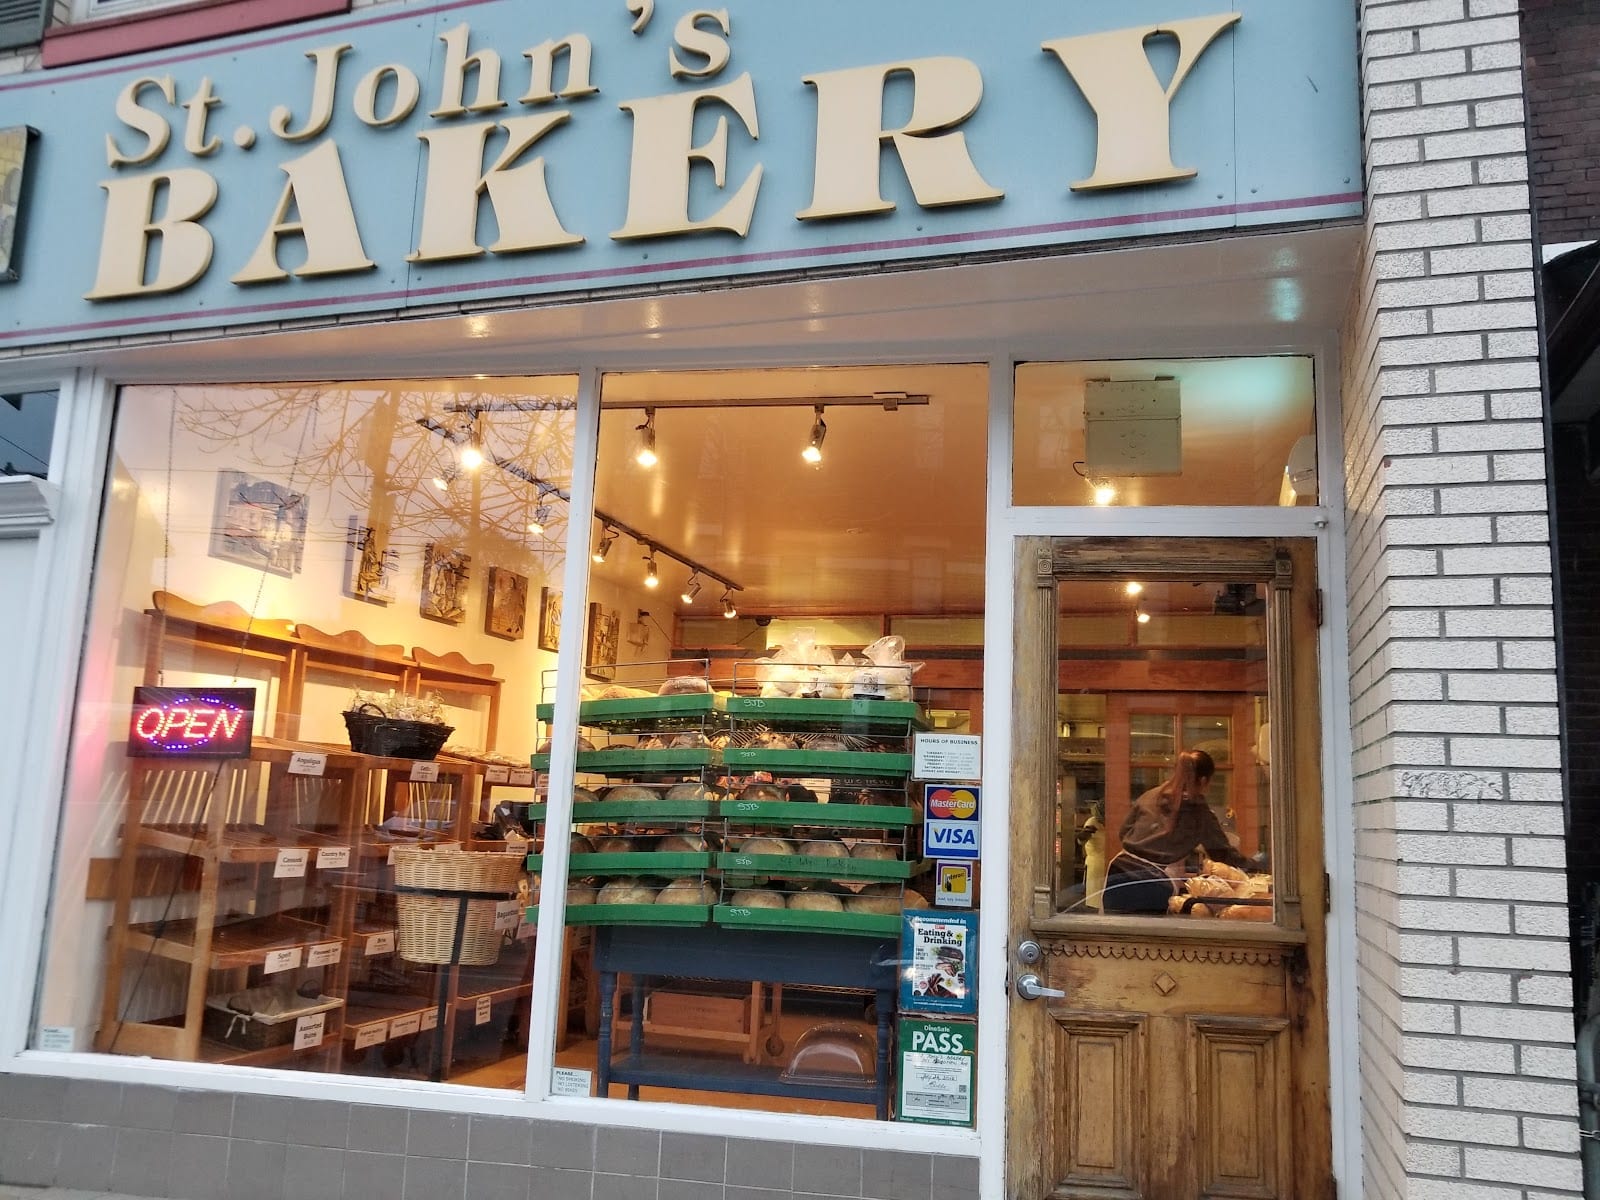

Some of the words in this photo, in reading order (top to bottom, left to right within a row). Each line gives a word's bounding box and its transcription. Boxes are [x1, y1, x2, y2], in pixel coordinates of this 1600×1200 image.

[83, 12, 1242, 303] BAKERY
[136, 708, 244, 739] OPEN
[930, 799, 975, 809] MasterCard
[934, 828, 976, 845] VISA
[918, 929, 946, 938] Eating
[946, 930, 954, 938] &
[923, 936, 963, 947] Drinking
[912, 1031, 964, 1054] PASS
